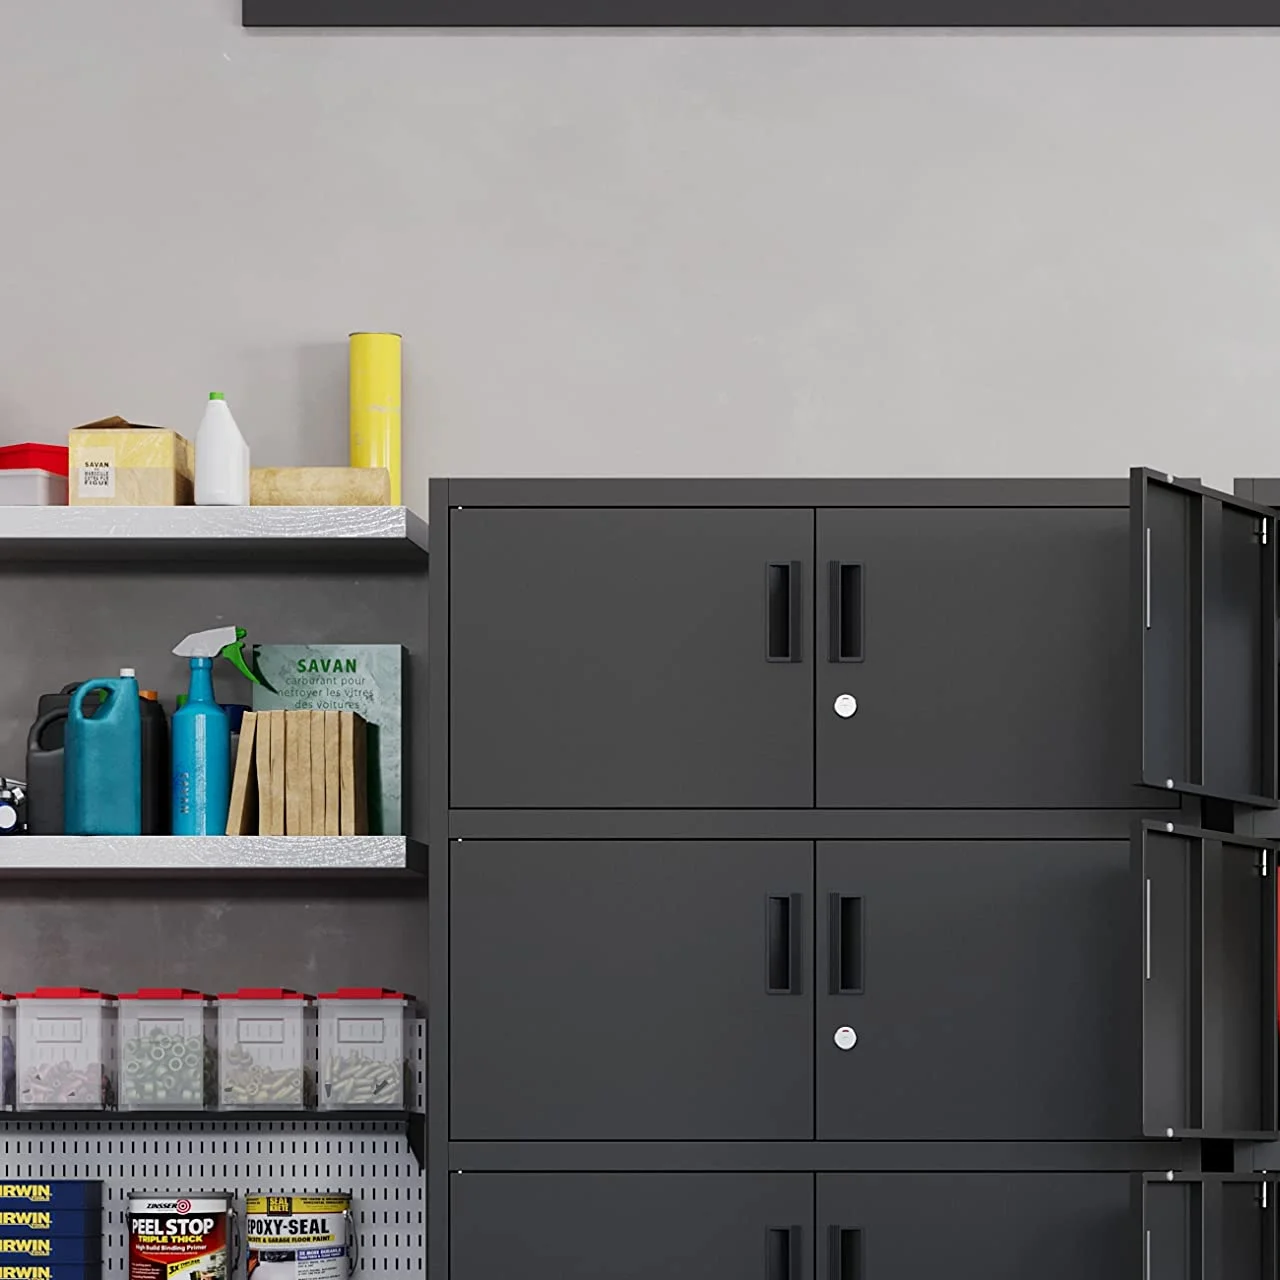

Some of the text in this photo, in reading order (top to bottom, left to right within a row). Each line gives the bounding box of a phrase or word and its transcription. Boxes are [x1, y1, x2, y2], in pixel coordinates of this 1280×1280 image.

[297, 659, 357, 673] SAVAN
[286, 677, 365, 689] carburant pour
[326, 688, 341, 696] les
[294, 700, 360, 710] des voitures
[132, 1218, 215, 1236] PEEL STOP
[138, 1235, 204, 1244] TRIPLE THICK
